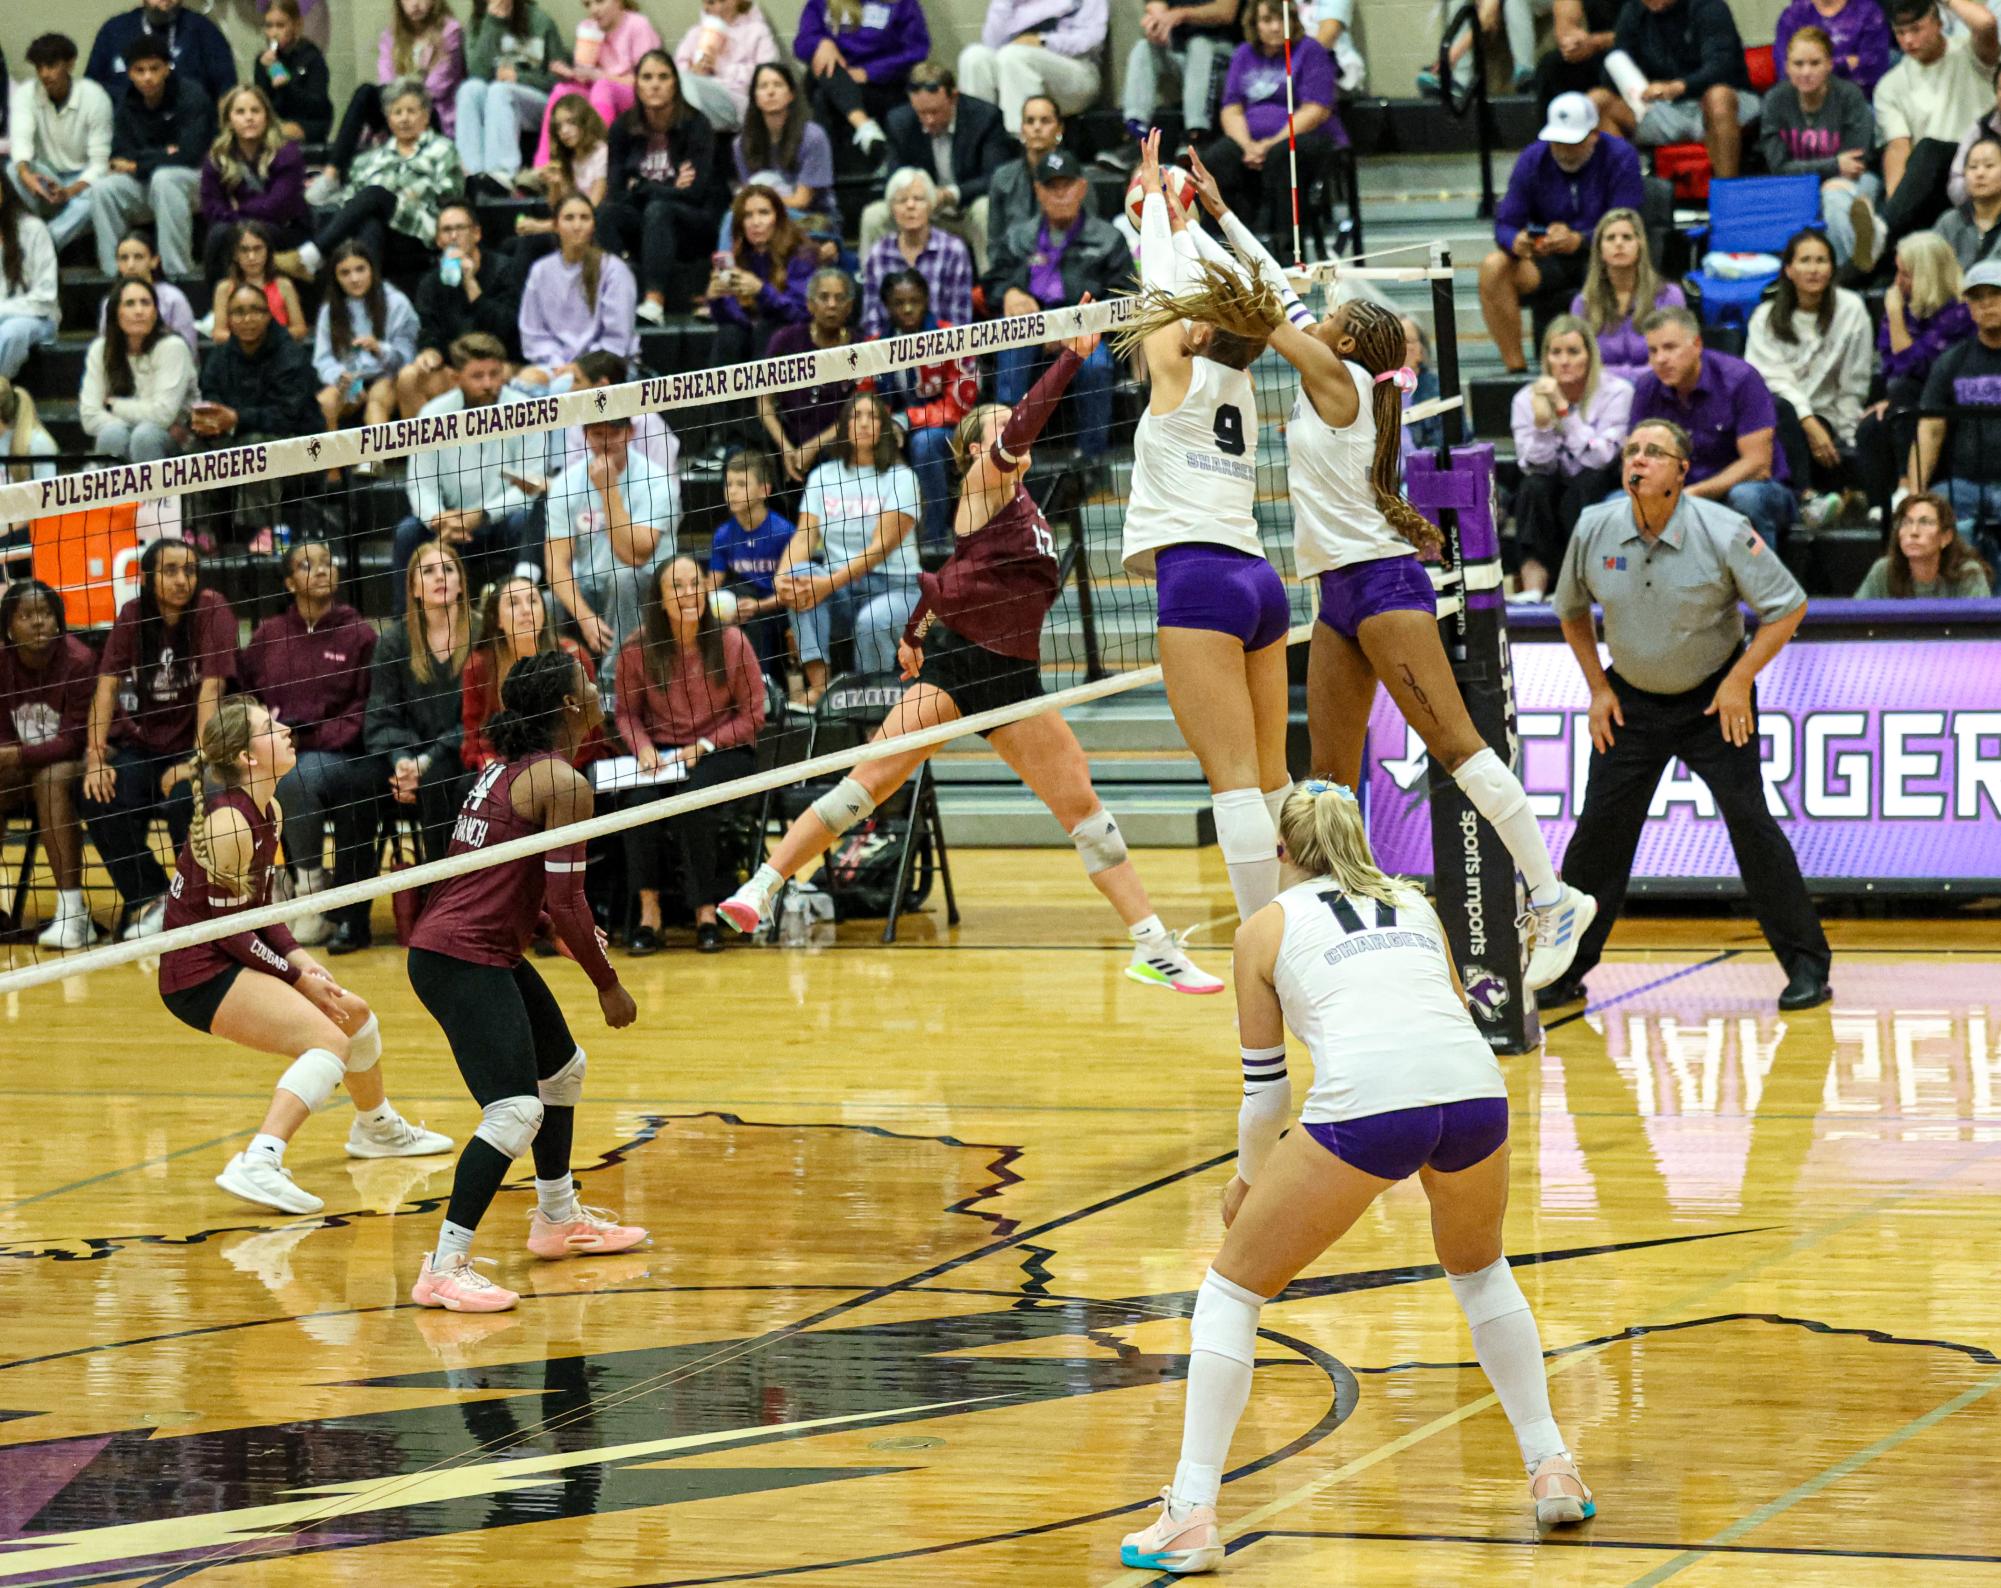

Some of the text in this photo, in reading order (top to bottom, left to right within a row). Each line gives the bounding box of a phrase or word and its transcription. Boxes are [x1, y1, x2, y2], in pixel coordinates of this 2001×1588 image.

[889, 314, 1046, 365] FULSHEAR CHARGERS
[641, 355, 816, 406] FULSHEAR CHARGERS
[360, 397, 559, 455] FULSHEAR CHARGERS
[1213, 403, 1246, 457] 9
[41, 446, 268, 509] FULSHEAR CHARGERS
[1459, 810, 1488, 957] sports imports
